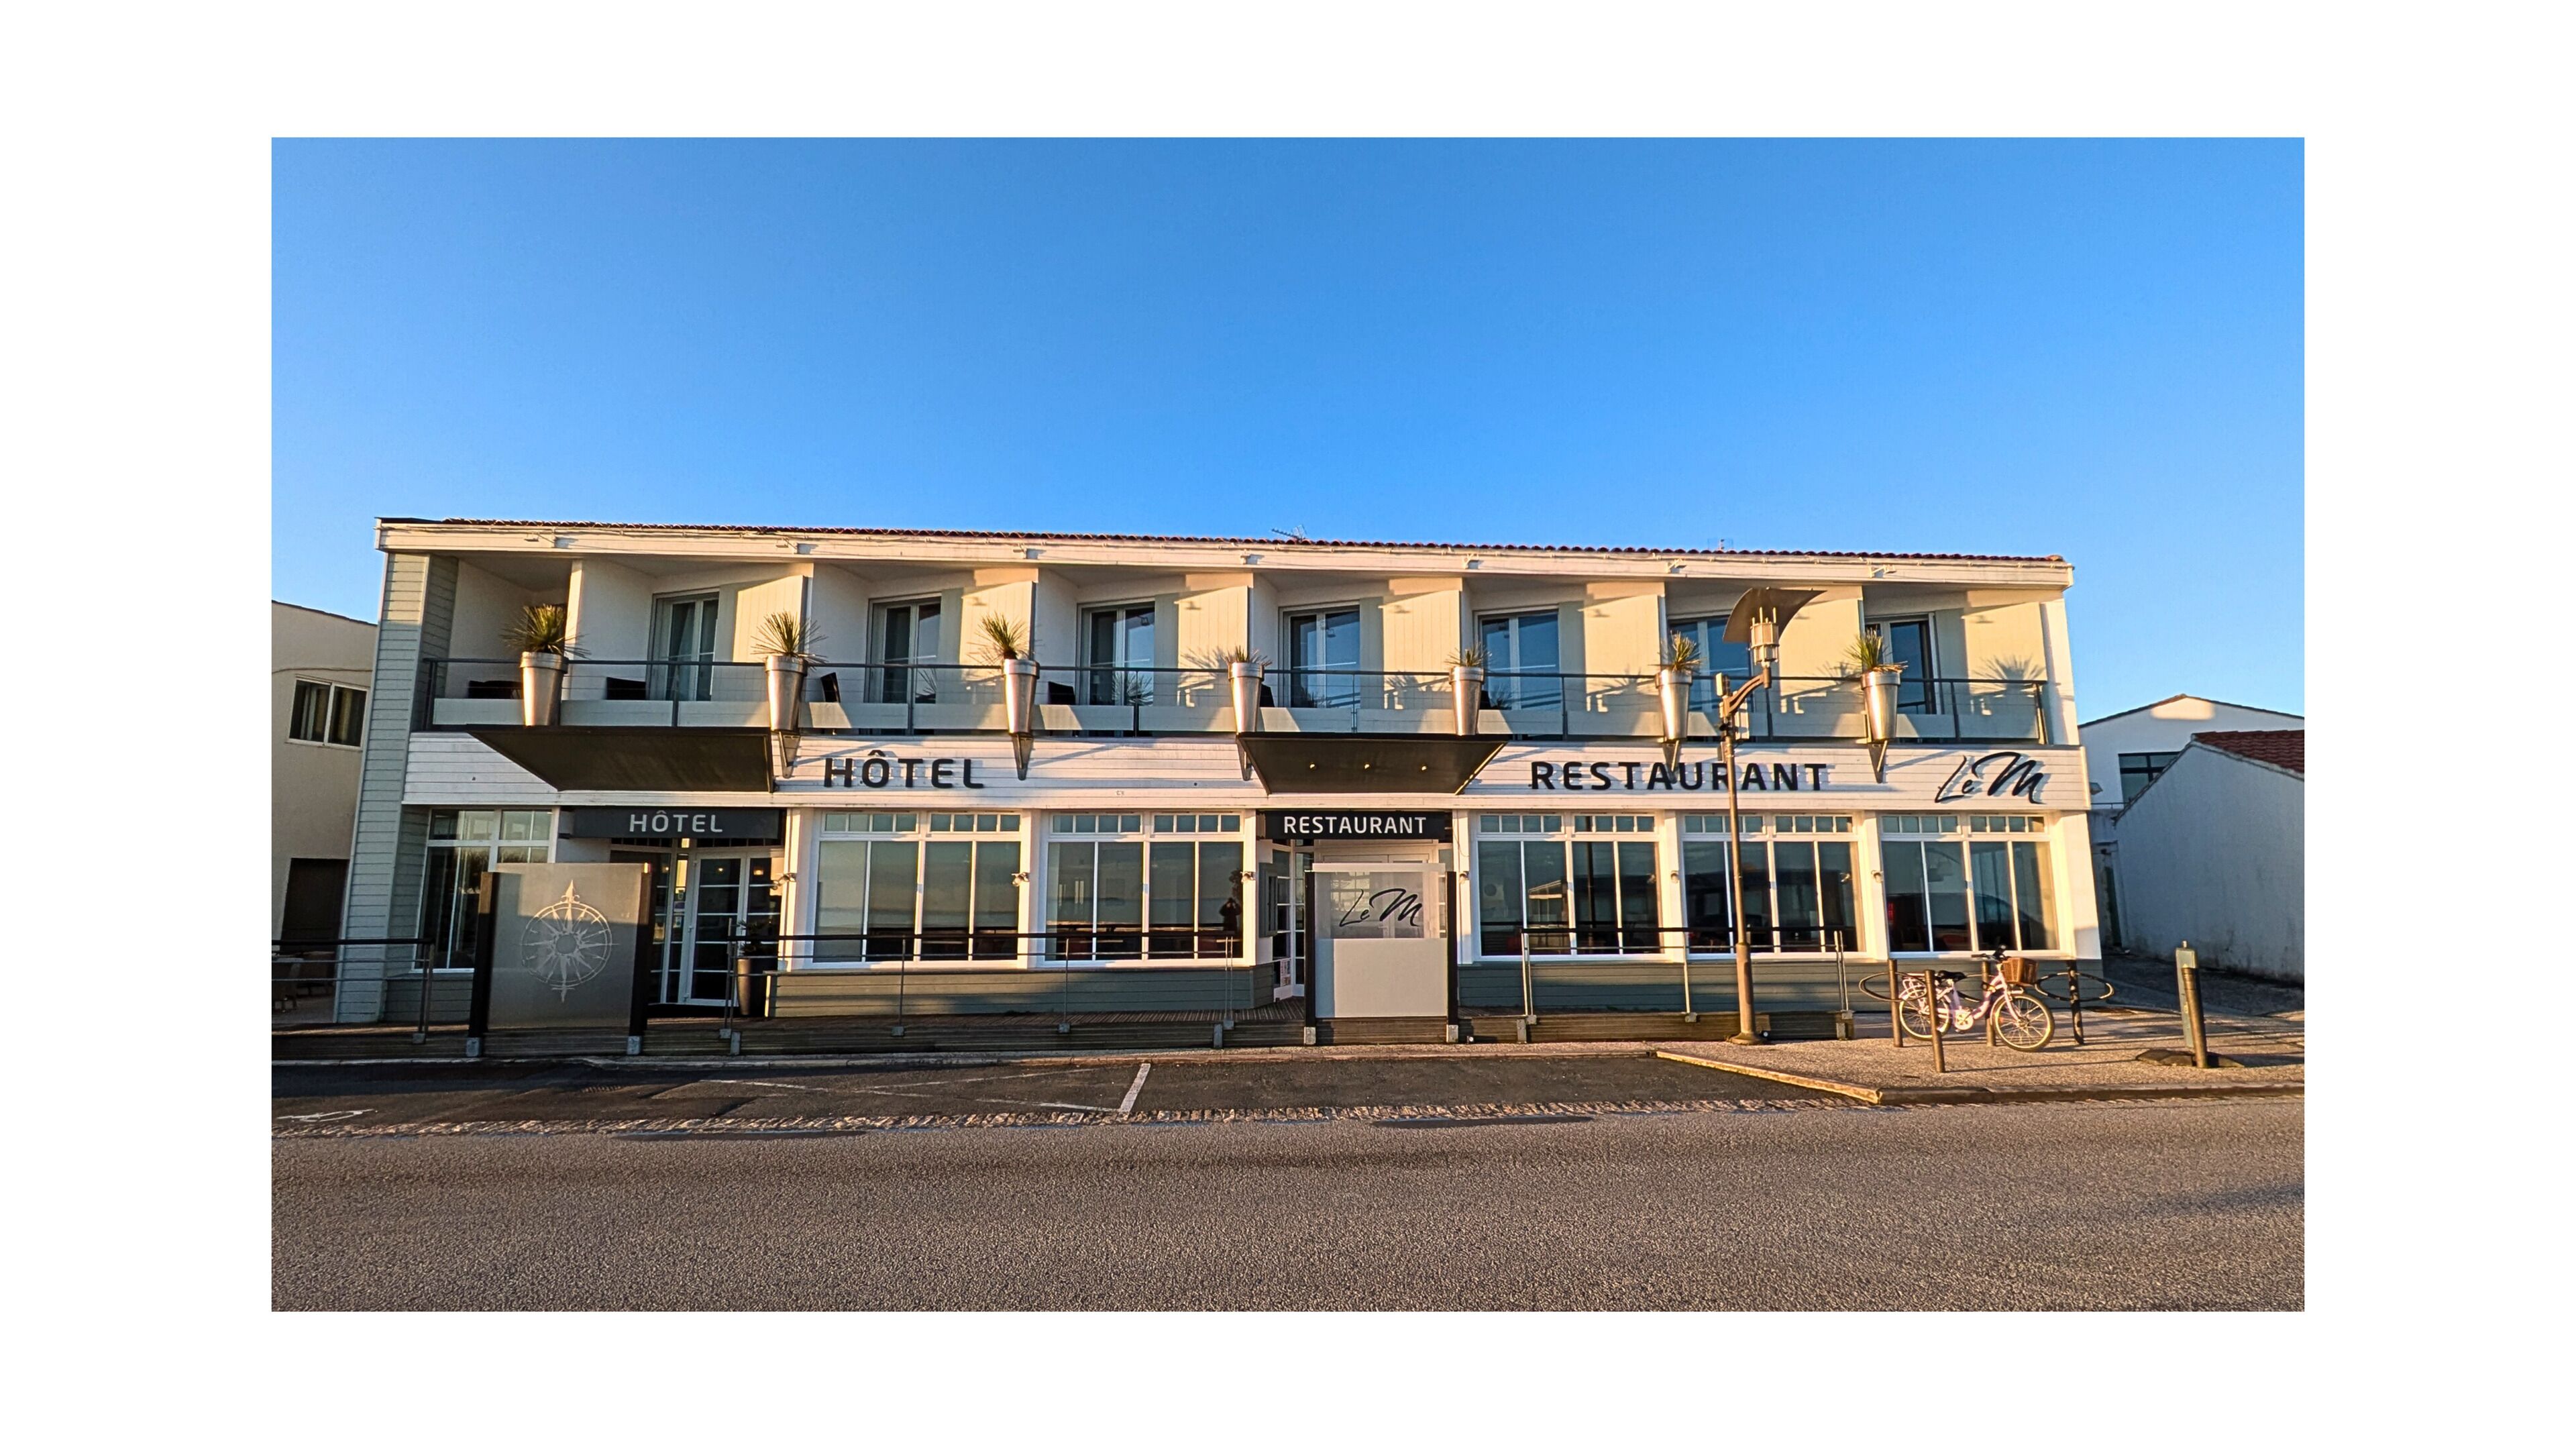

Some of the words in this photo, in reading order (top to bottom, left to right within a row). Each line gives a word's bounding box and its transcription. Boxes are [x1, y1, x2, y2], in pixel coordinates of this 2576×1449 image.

[824, 749, 983, 788] HÔTEL
[1531, 761, 1827, 790] RESTAURANT
[629, 810, 722, 833] HÔTEL
[1284, 816, 1426, 834] RESTAURANT
